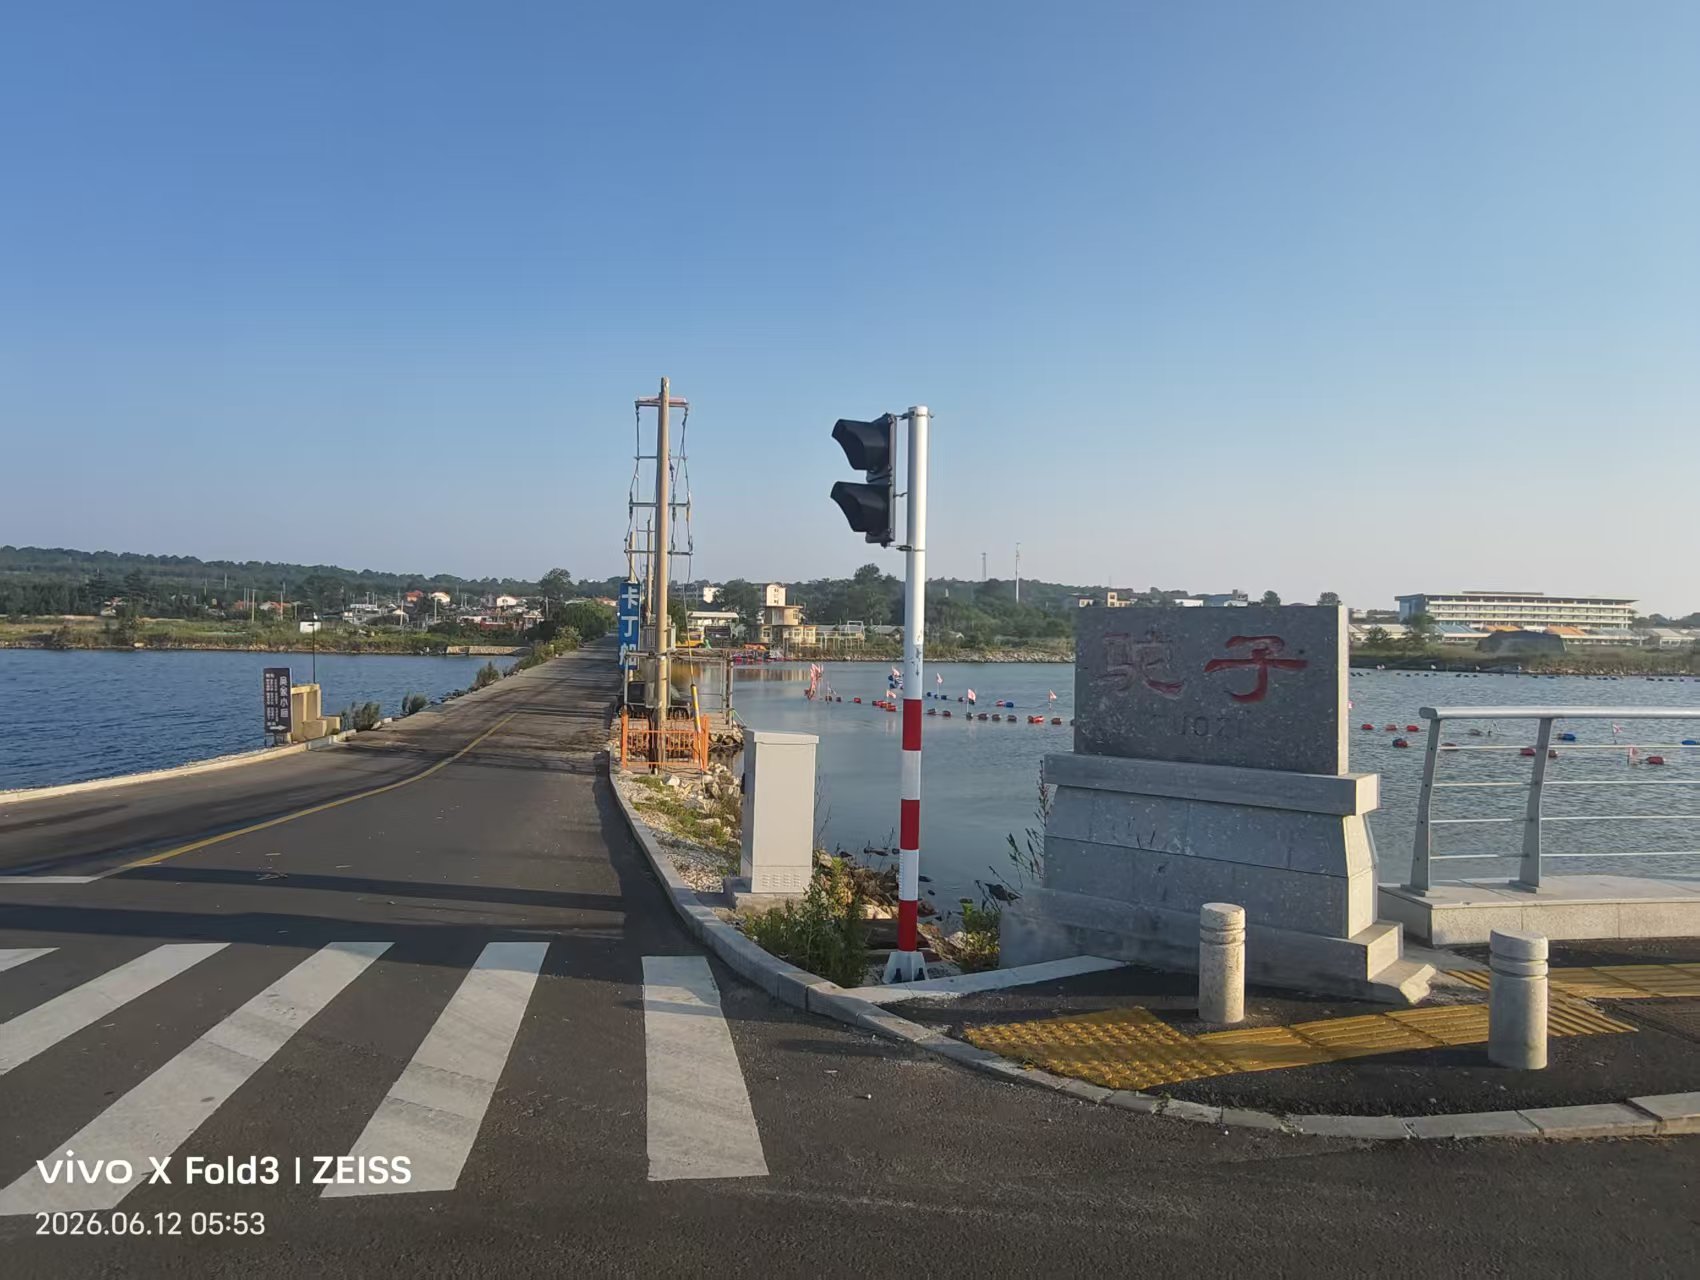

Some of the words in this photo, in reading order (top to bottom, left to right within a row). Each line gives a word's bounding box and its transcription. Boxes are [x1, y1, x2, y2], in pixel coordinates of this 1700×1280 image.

[619, 586, 639, 665] 卡丁船
[1094, 628, 1309, 703] 驼子
